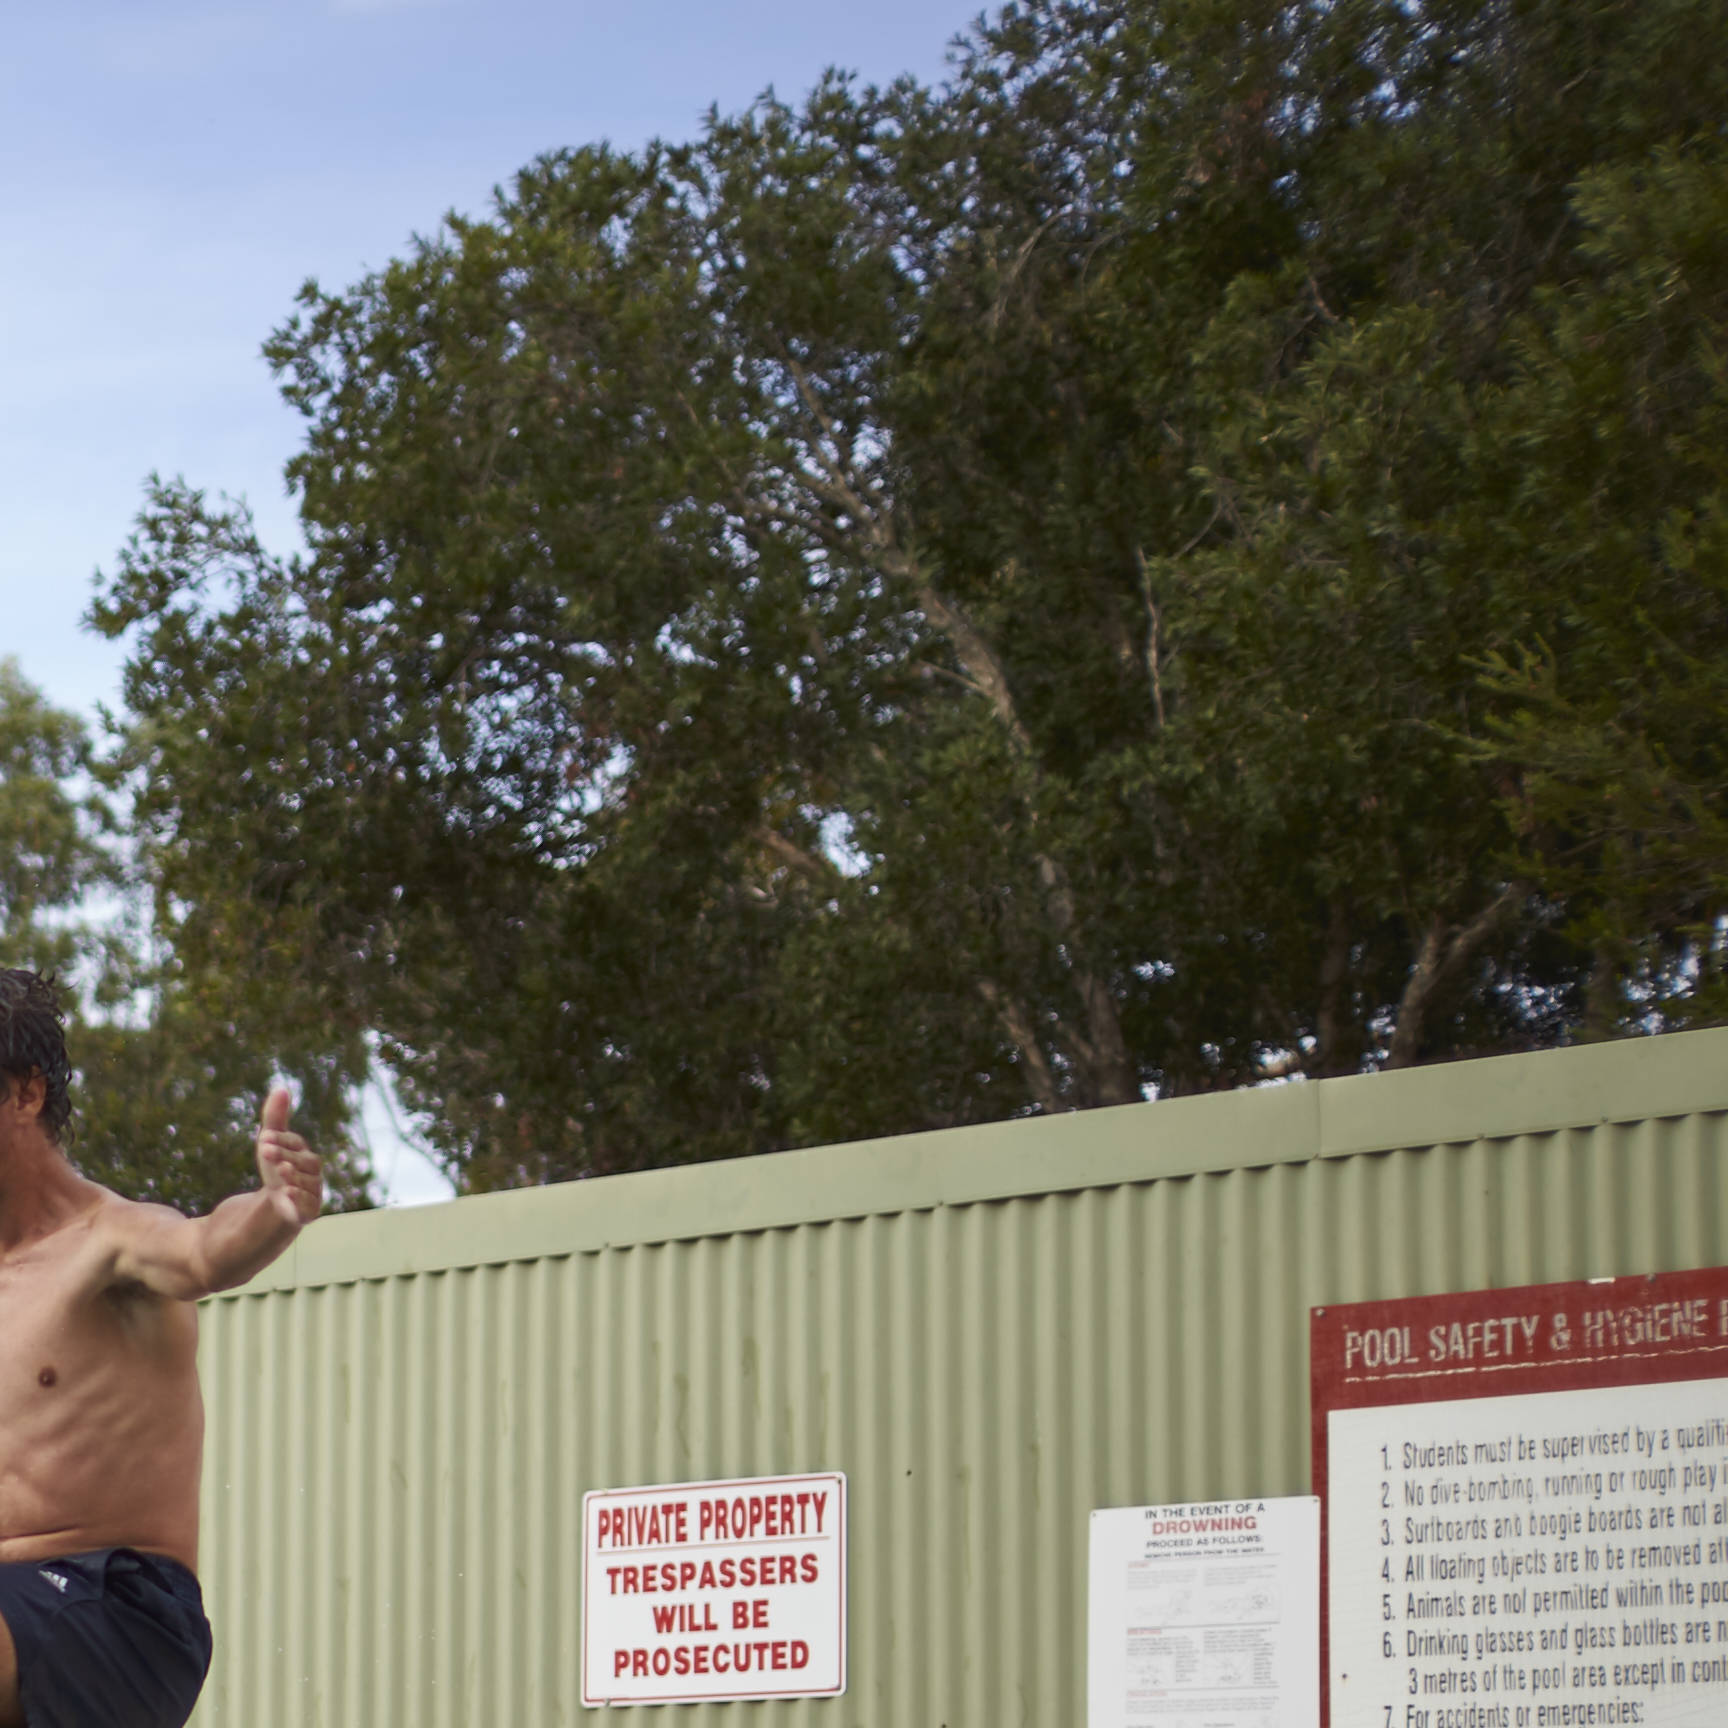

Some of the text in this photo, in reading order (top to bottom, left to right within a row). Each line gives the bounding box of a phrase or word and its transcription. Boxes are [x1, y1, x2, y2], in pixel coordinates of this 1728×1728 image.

[1345, 1326, 1419, 1369] POOL
[1429, 1315, 1540, 1362] SAFETY
[1550, 1312, 1572, 1350] &
[1583, 1299, 1708, 1348] HYGIENE
[1381, 1444, 1392, 1470] 1.
[1403, 1440, 1468, 1469] Students
[1474, 1436, 1512, 1463] must
[1518, 1434, 1536, 1460] be
[1636, 1424, 1656, 1458] by
[1661, 1429, 1670, 1450] a
[1381, 1482, 1394, 1508] 2.
[1405, 1480, 1424, 1507] No
[1544, 1467, 1602, 1500] running
[1609, 1471, 1625, 1492] or
[1633, 1461, 1676, 1495] rough
[1683, 1459, 1717, 1494] play
[598, 1491, 827, 1549] PRIVATE PROPERTY
[1145, 1502, 1266, 1519] IN THE EVENT OF A
[1152, 1516, 1257, 1535] DROWNING
[1381, 1519, 1394, 1546] 3.
[1495, 1512, 1522, 1538] and
[1529, 1506, 1581, 1541] boogie
[1588, 1503, 1643, 1533] boards
[1650, 1506, 1675, 1528] are
[1682, 1499, 1706, 1526] not
[1146, 1538, 1193, 1549] PROCEED
[1381, 1556, 1395, 1583] 4.
[1405, 1554, 1424, 1582] All
[1493, 1548, 1547, 1582] objects
[1554, 1551, 1578, 1573] are
[1585, 1545, 1599, 1571] to
[1607, 1543, 1624, 1570] be
[1631, 1537, 1701, 1568] removed
[606, 1553, 819, 1595] TRESPASSERS
[652, 1599, 769, 1634] WILL BE
[1382, 1594, 1395, 1620] 5.
[1407, 1590, 1466, 1619] Animals
[1473, 1594, 1497, 1615] are
[1503, 1587, 1526, 1613] not
[1533, 1581, 1609, 1617] permitted
[1616, 1578, 1663, 1607] within
[1669, 1577, 1694, 1605] the
[614, 1640, 810, 1678] PROSECUTED
[1383, 1631, 1396, 1658] 6.
[1407, 1628, 1469, 1660] Drinking
[1476, 1626, 1534, 1660] glasses
[1541, 1621, 1568, 1650] and
[1575, 1621, 1616, 1656] glass
[1623, 1617, 1678, 1646] bottles
[1685, 1621, 1711, 1644] are
[1409, 1667, 1418, 1695] 3
[1424, 1667, 1478, 1694] metres
[1483, 1664, 1497, 1692] of
[1503, 1663, 1526, 1690] the
[1532, 1661, 1566, 1696] pool
[1573, 1665, 1607, 1688] area
[1613, 1657, 1666, 1691] except
[1671, 1655, 1686, 1683] in
[1517, 1706, 1531, 1727] or
